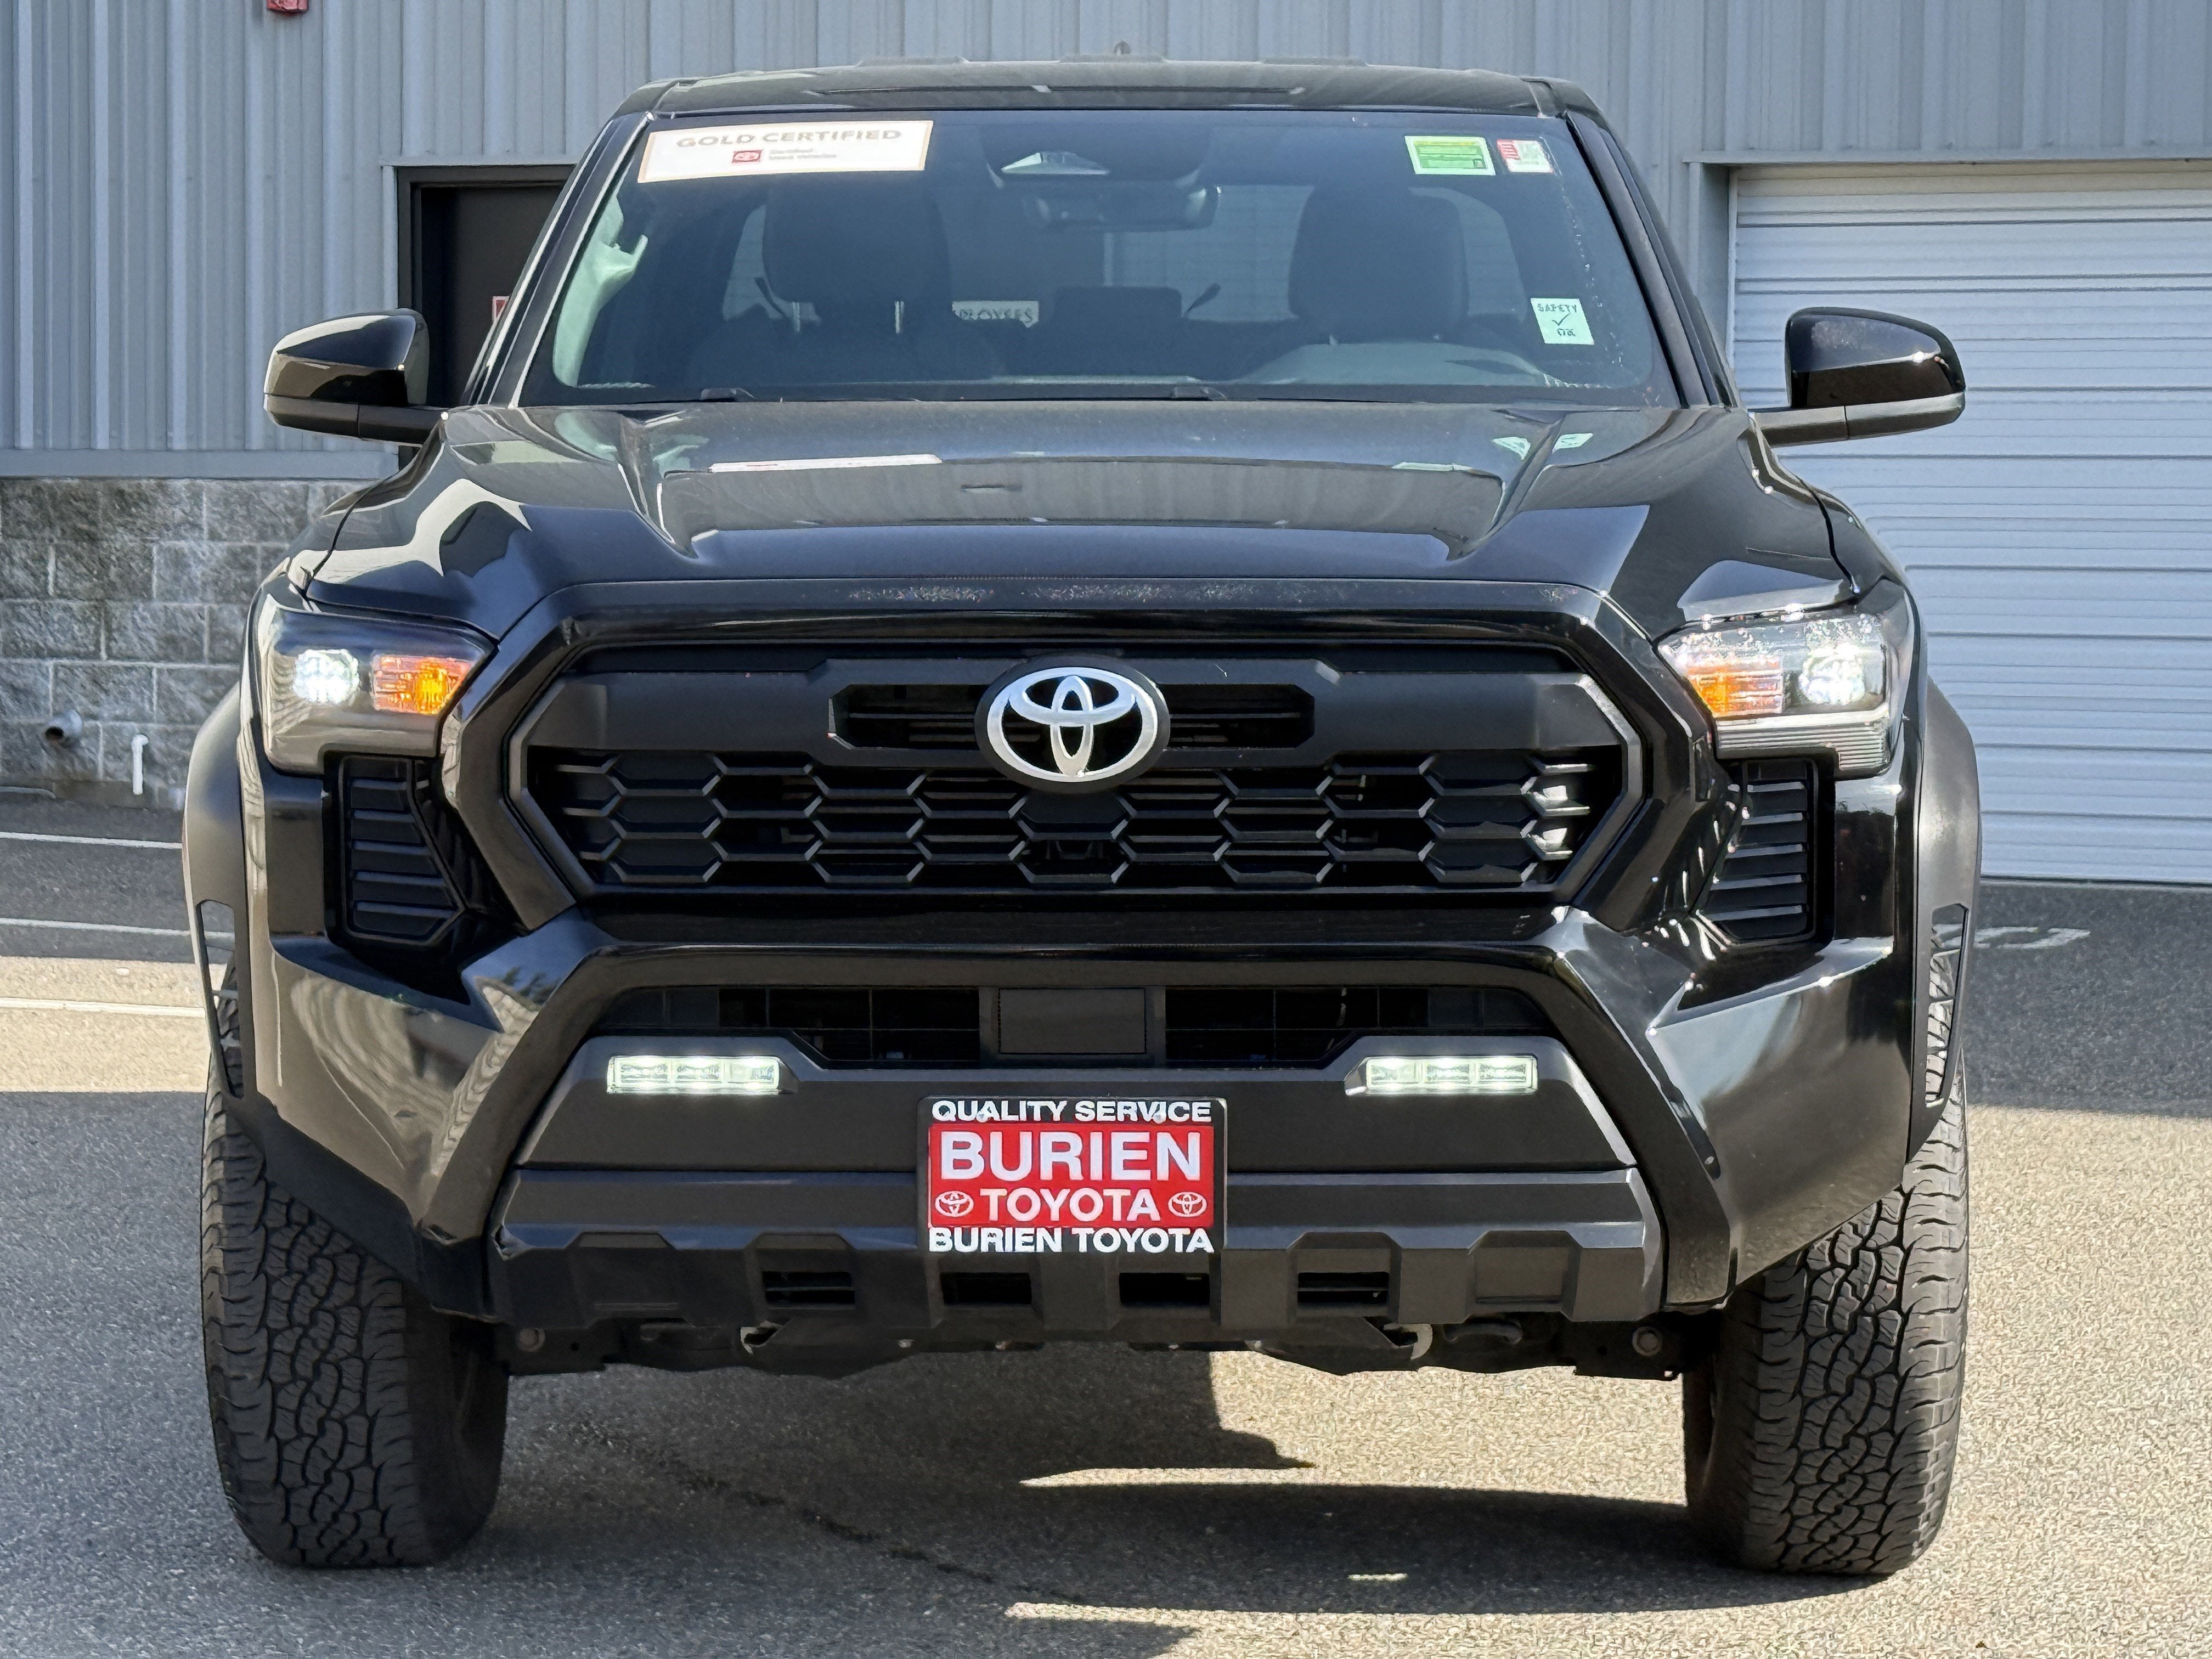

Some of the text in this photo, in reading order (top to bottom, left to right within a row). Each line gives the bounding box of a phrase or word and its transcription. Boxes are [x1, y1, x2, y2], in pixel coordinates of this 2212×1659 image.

[676, 129, 902, 148] GOLD CERTIFIED
[1537, 303, 1577, 313] SAFETY
[932, 1101, 1212, 1122] QUALITY SERVICE
[941, 1131, 1201, 1181] BURIEN
[980, 1188, 1161, 1221] TOYOTA
[929, 1227, 1215, 1253] BURIEN TOYOTA
